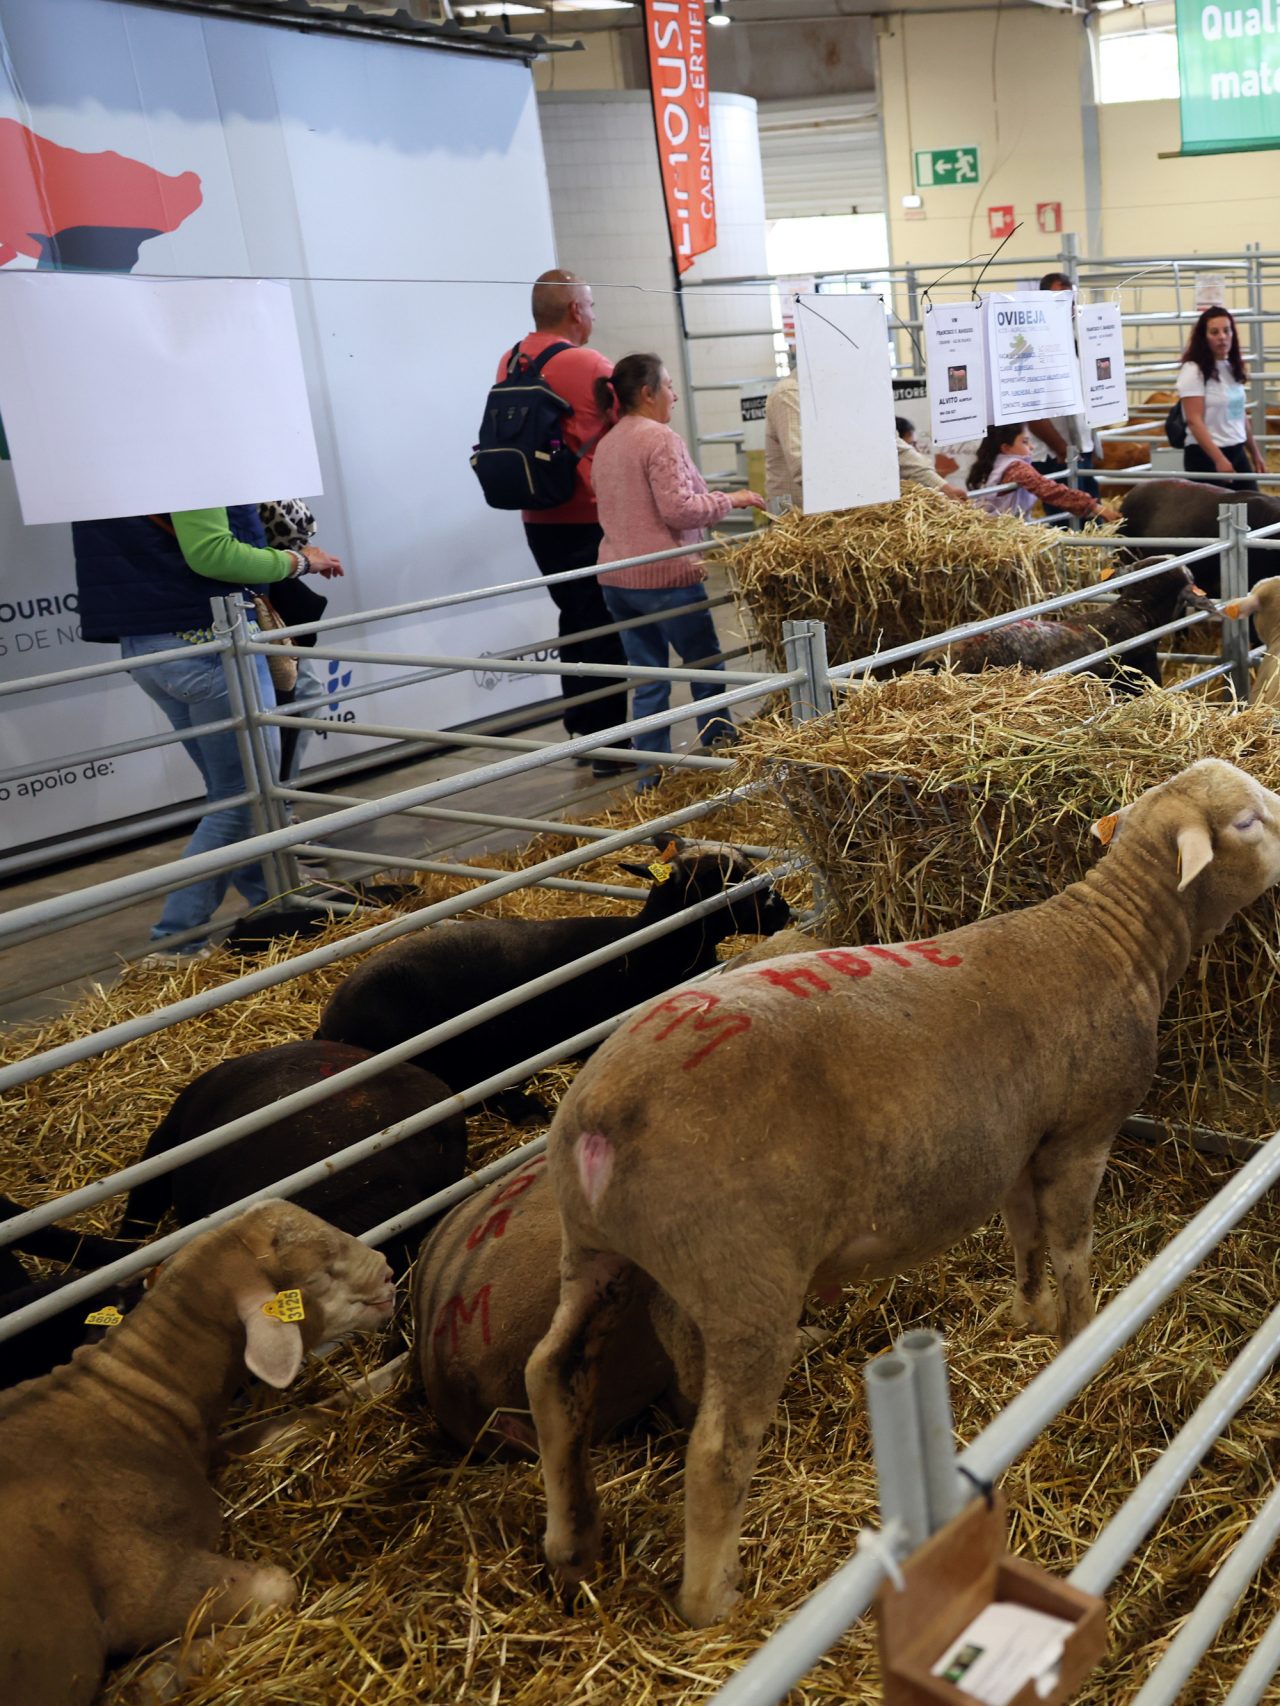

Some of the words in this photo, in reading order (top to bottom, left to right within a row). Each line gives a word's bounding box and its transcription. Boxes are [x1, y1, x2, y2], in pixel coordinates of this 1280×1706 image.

[699, 124, 714, 220] CARNE
[997, 311, 1046, 326] OVIBEJA
[939, 396, 958, 405] ALVITO
[14, 625, 50, 652] DE
[17, 768, 77, 797] apoio
[83, 760, 115, 777] de:
[287, 1291, 302, 1320] 3125
[88, 1315, 119, 1325] 3605
